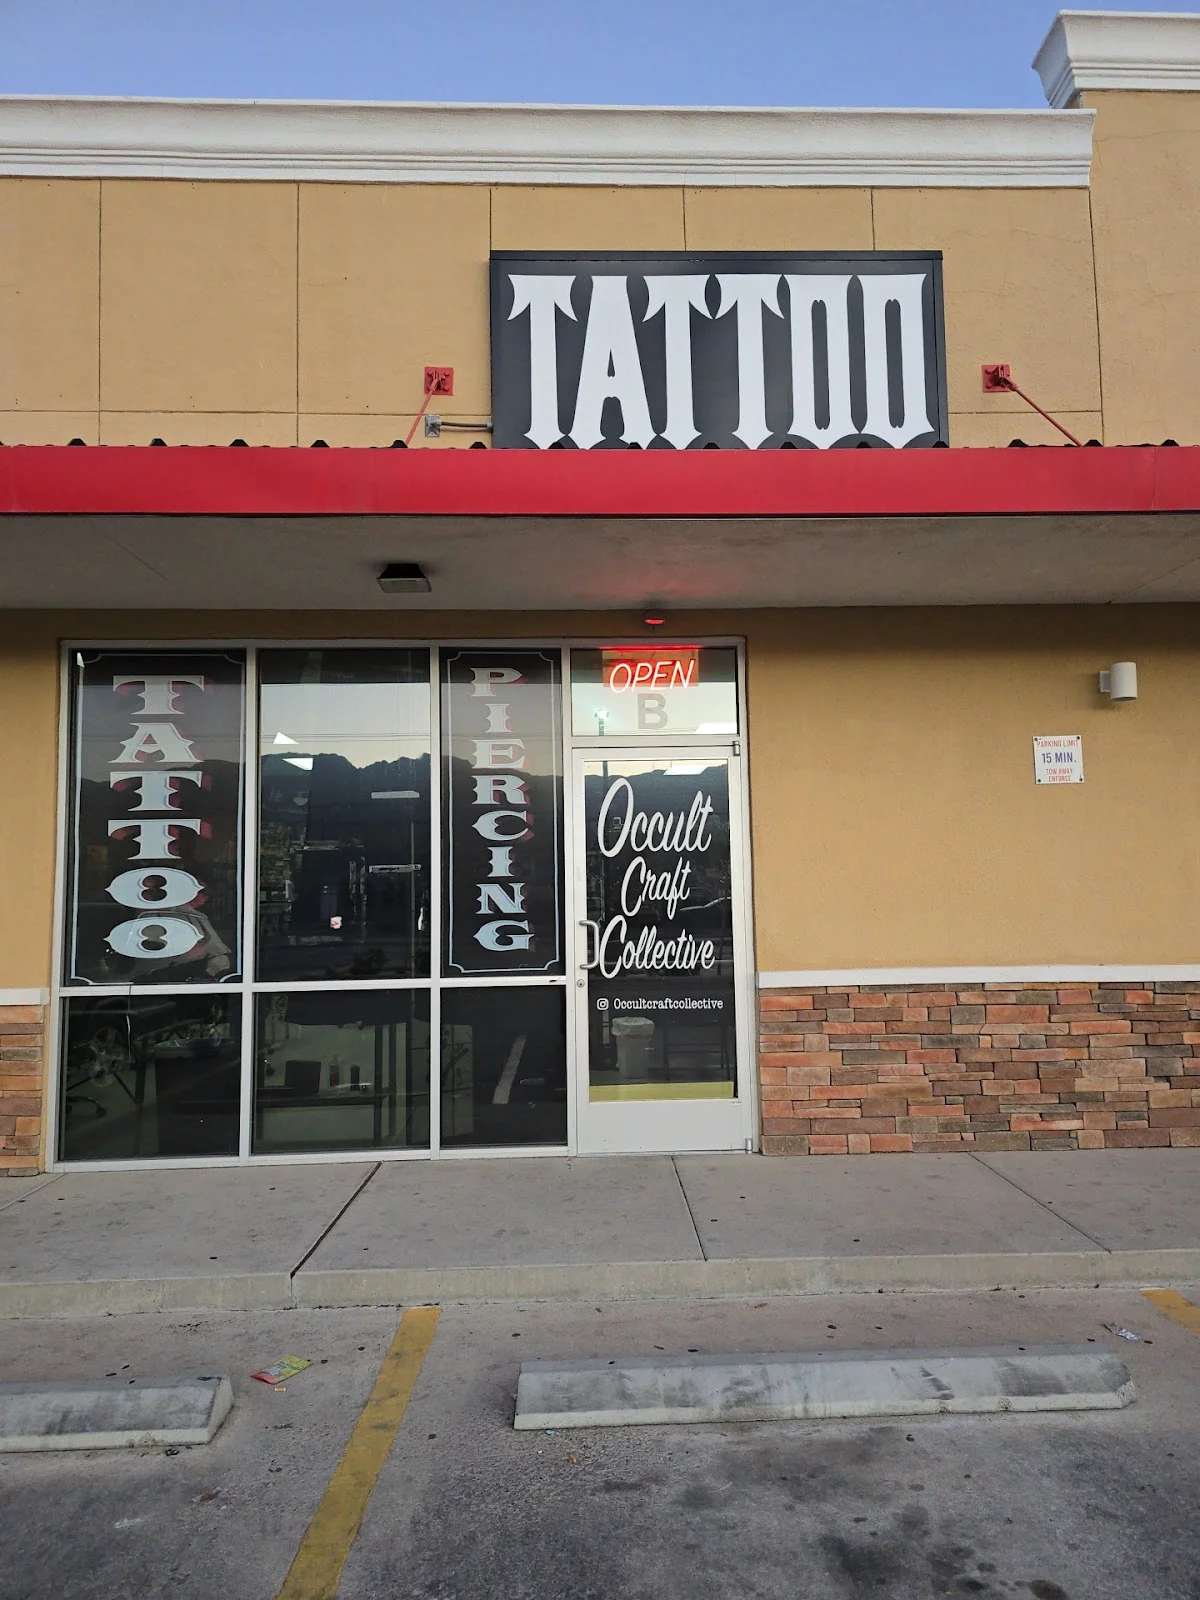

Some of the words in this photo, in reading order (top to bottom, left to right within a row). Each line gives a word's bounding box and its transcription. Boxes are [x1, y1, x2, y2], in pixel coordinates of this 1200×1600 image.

[507, 274, 934, 450] TATTOO
[610, 659, 695, 694] OPEN
[638, 693, 668, 729] B
[1041, 752, 1052, 764] 15
[1054, 752, 1077, 763] MIN.
[103, 675, 206, 959] TATTOO
[470, 667, 535, 952] PIERCING
[597, 777, 714, 858] Occult
[621, 856, 692, 920] Craft
[600, 914, 716, 979] Collective
[613, 997, 724, 1010] Occultcraftcollective
